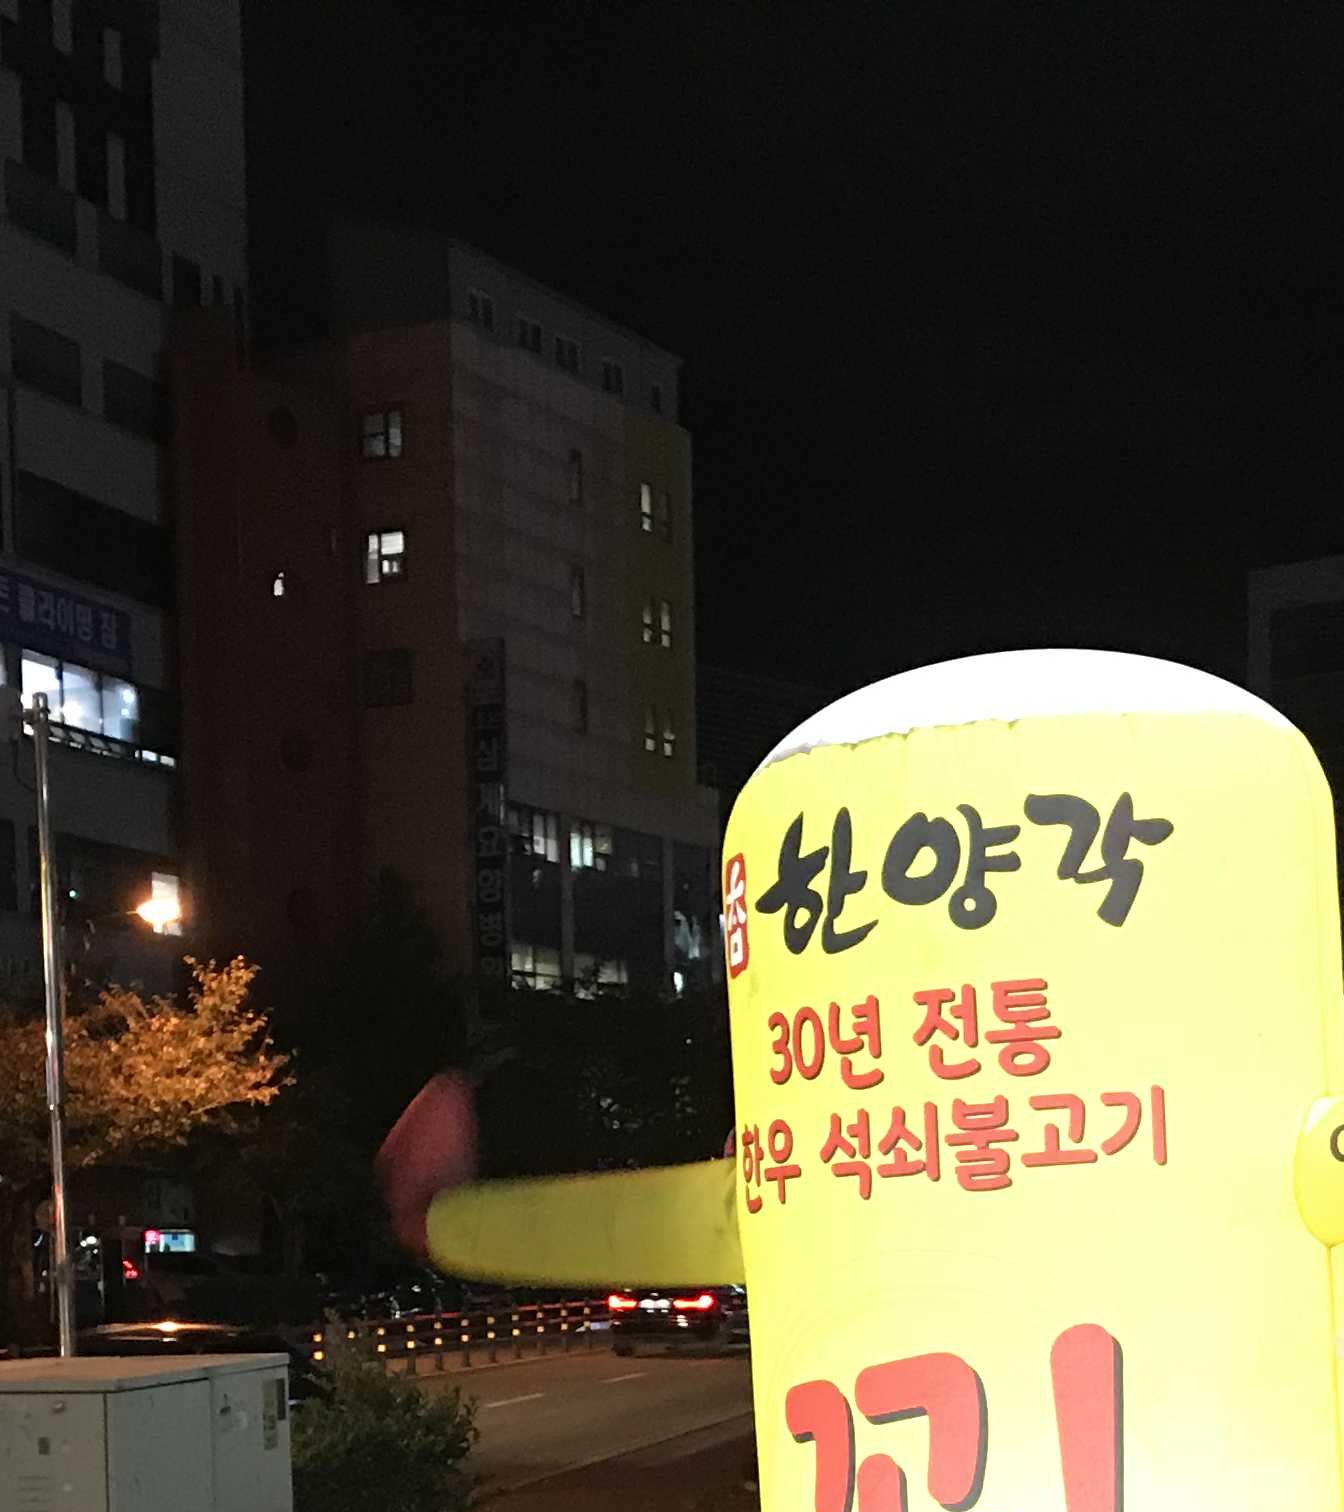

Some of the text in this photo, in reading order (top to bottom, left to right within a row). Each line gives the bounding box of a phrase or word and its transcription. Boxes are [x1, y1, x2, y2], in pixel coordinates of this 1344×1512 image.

[755, 791, 1174, 956] 한양각
[767, 977, 1062, 1090] 30년 전통
[741, 1085, 1169, 1213] 한우 석쇠불고기
